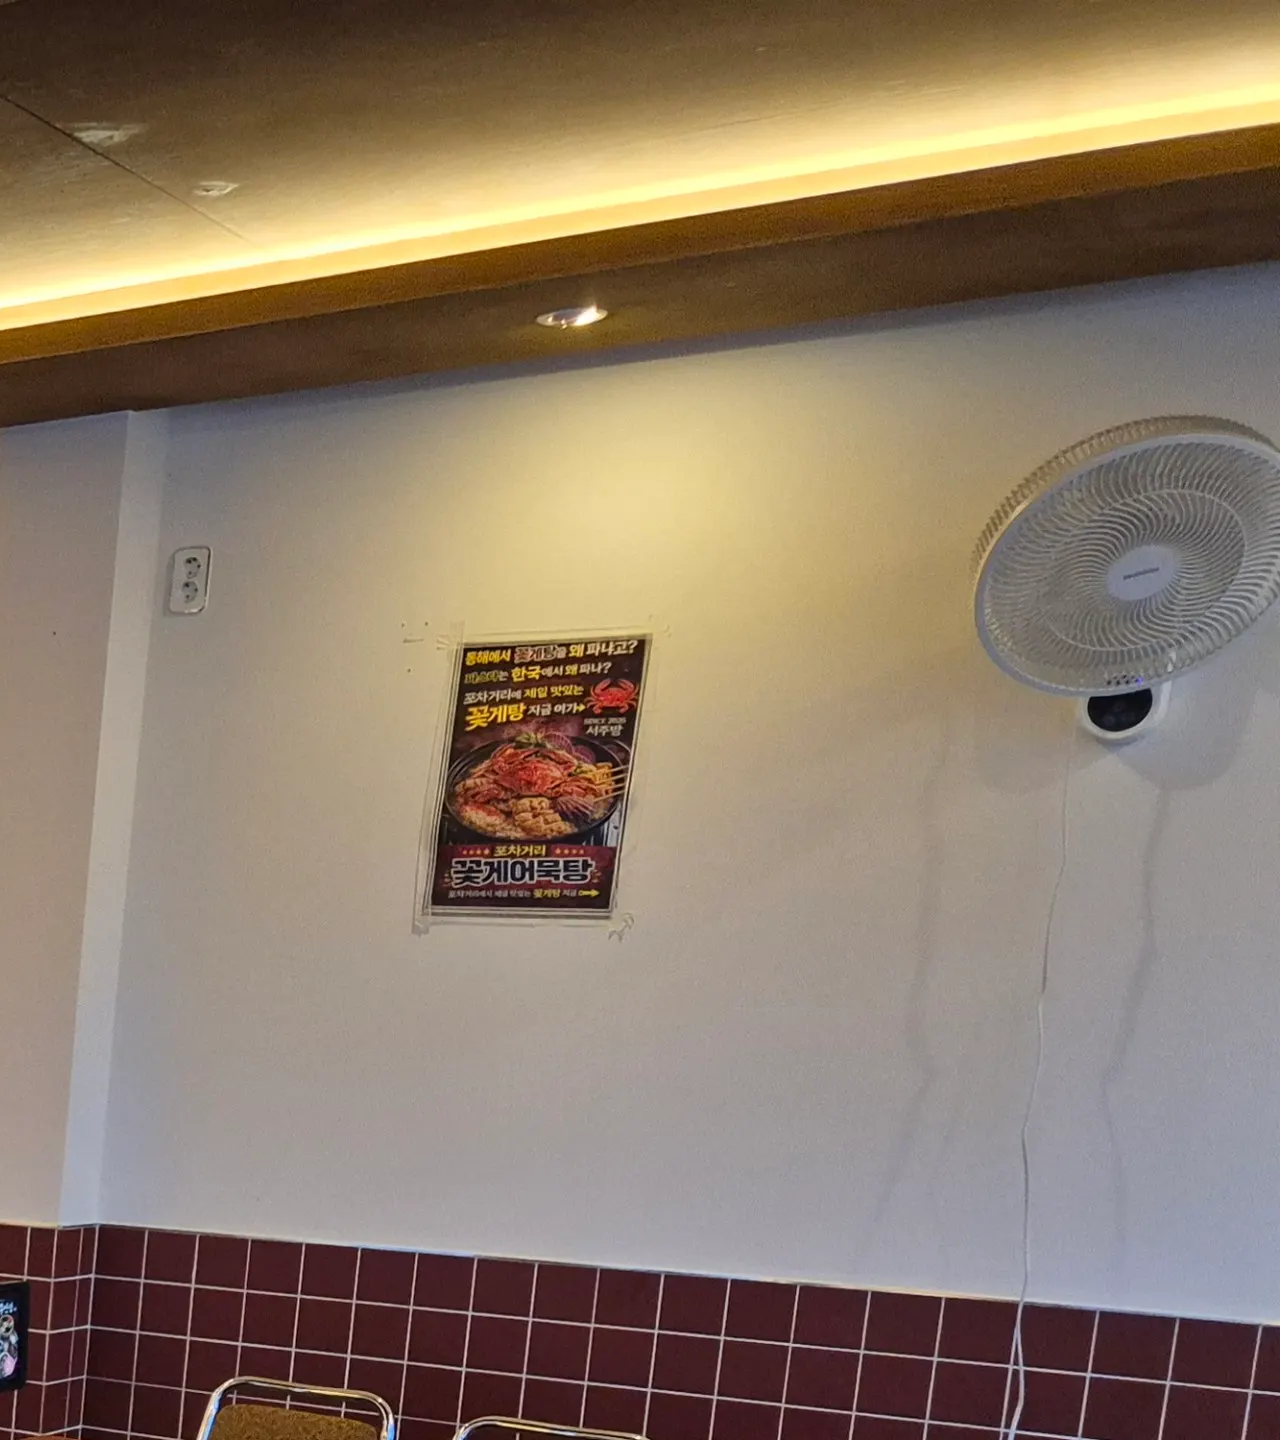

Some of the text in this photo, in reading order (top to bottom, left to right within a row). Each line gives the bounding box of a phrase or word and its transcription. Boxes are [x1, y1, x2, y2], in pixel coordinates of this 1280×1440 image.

[569, 644, 584, 657] 왜
[586, 640, 638, 656] 파냐고?
[511, 664, 563, 682] 한국에서
[565, 663, 578, 676] 왜
[523, 686, 548, 699] 제일
[550, 684, 584, 697] 맛있는
[464, 702, 527, 732] 꽃게탕
[527, 703, 552, 717] 지금
[493, 844, 546, 857] 포차거리
[451, 857, 596, 888] 꽃게어묵탕
